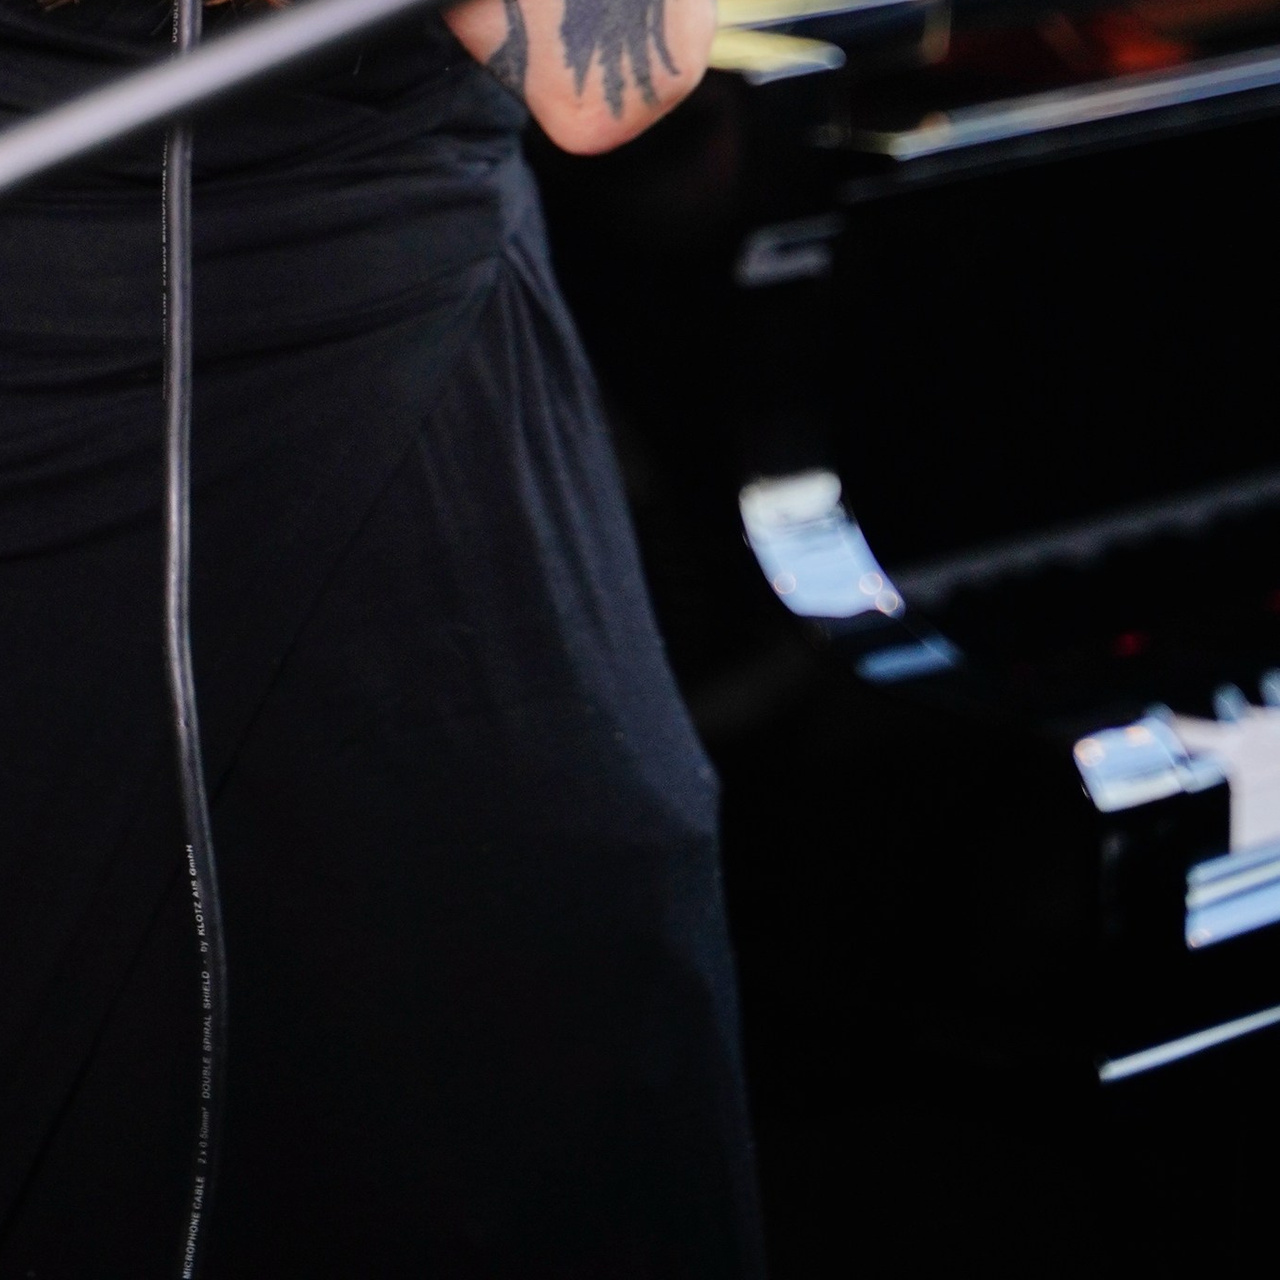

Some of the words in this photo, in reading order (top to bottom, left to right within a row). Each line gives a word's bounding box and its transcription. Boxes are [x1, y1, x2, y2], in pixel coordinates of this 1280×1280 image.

[185, 844, 197, 877] GmbH
[193, 901, 206, 937] KLOTZ
[200, 940, 209, 953] by
[203, 971, 212, 1009] SHIELD
[203, 1015, 212, 1052] SPIRAL
[201, 1056, 212, 1099] DOUBLE
[193, 1175, 206, 1209] CABLE
[182, 1212, 201, 1279] MICROPHONE
